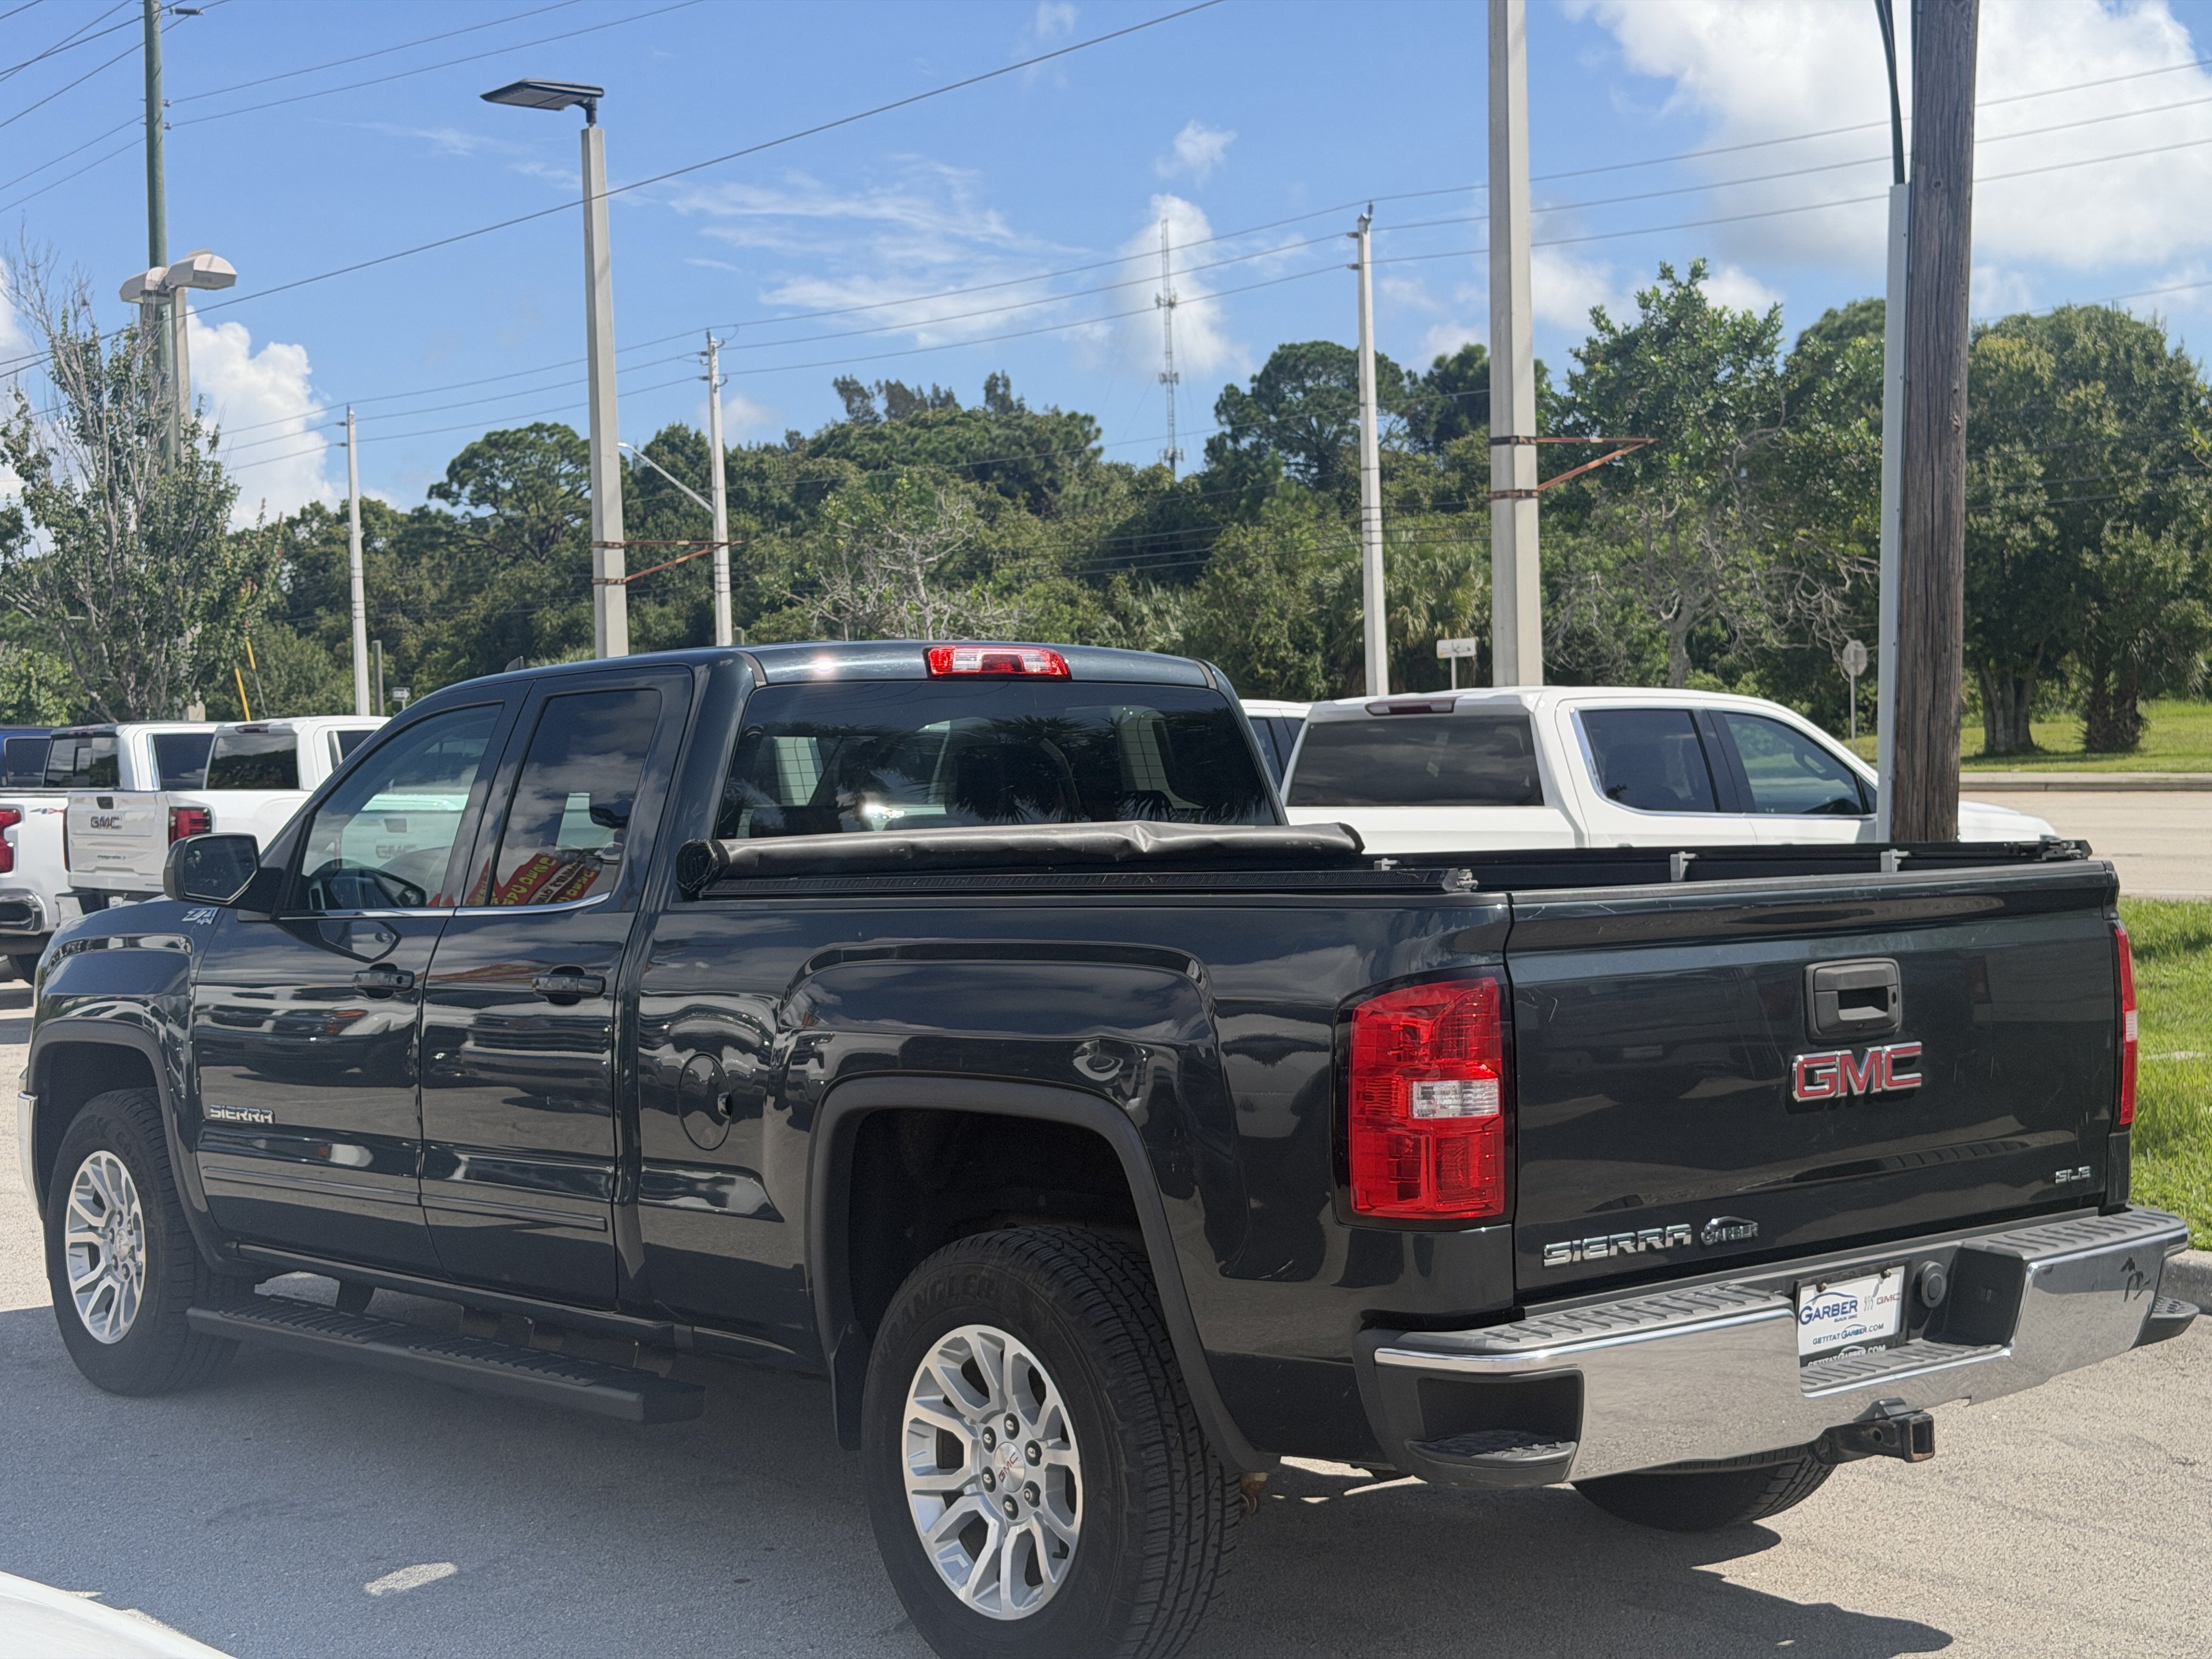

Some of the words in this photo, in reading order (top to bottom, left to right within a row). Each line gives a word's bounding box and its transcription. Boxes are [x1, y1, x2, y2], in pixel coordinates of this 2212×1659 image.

[91, 815, 122, 829] GMC
[1792, 1041, 1922, 1102] GMC
[210, 1104, 275, 1124] SIERRA
[2055, 1166, 2091, 1184] SLE
[1543, 1223, 1692, 1267] SIERRA
[1876, 1293, 1900, 1305] GMC
[1799, 1299, 1858, 1325] GARBER
[998, 1451, 1019, 1483] GMC
